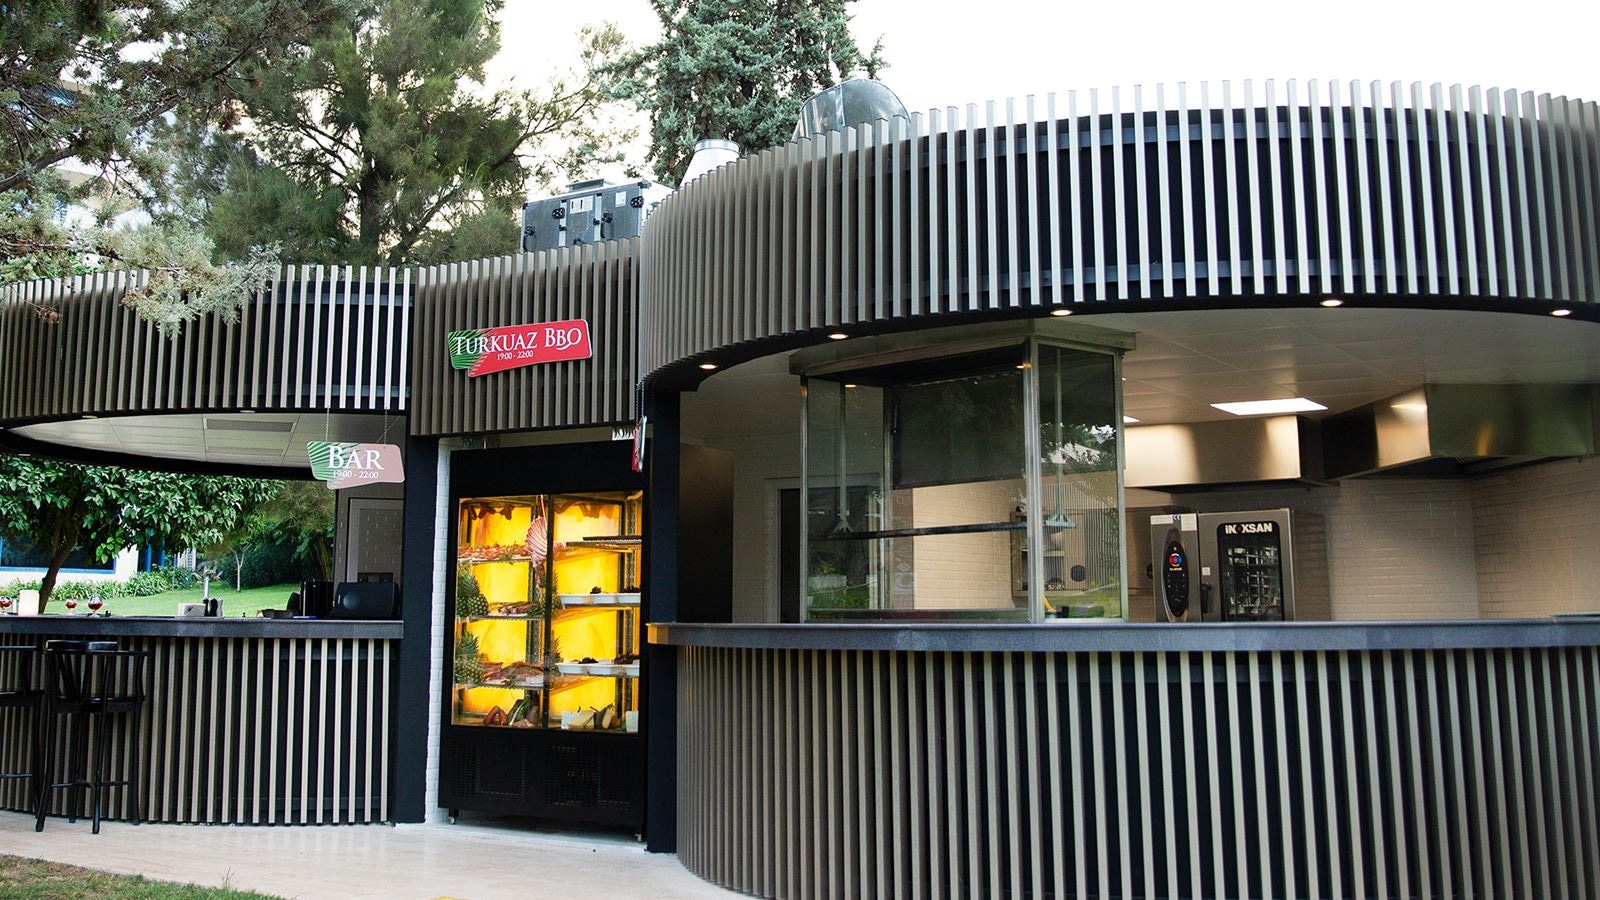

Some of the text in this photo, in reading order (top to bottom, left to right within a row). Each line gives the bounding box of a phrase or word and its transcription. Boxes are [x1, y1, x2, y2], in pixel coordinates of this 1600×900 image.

[453, 331, 538, 356] TURKUAZ
[497, 353, 513, 361] 19:00
[517, 350, 534, 359] 22:00
[327, 445, 384, 470] BAR
[333, 470, 353, 479] 19:00
[359, 471, 379, 479] 22:00
